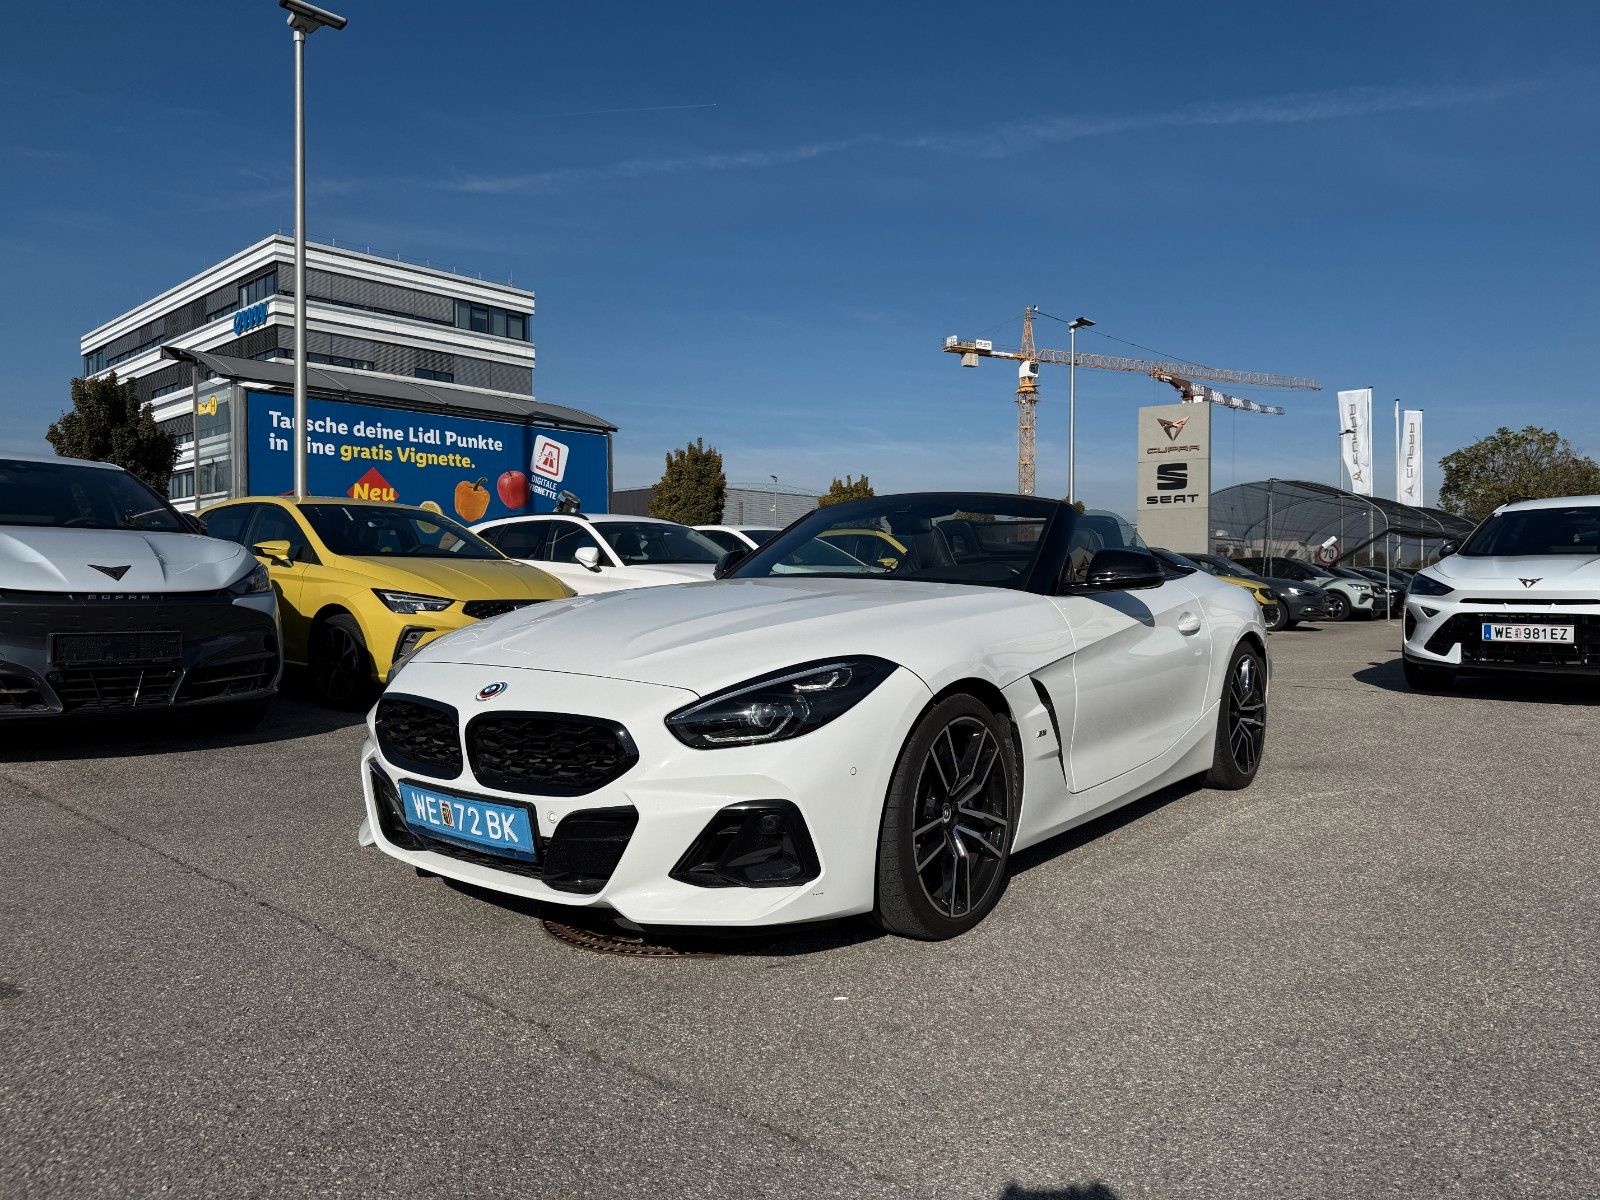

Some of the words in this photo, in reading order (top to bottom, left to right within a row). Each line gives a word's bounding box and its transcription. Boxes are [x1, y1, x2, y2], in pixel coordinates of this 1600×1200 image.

[269, 411, 348, 435] Tasche
[353, 421, 403, 441] deine
[409, 427, 441, 445] Lidl
[445, 431, 503, 451] Punkte
[269, 433, 289, 451] in
[304, 436, 336, 456] ine
[340, 444, 393, 462] gratis
[396, 446, 476, 468] Vignette.
[1147, 445, 1200, 455] CUPRA
[531, 474, 558, 491] DIGITALE
[353, 483, 396, 502] Neu
[529, 483, 558, 500] VIGNETTE
[1146, 494, 1199, 505] SEAT
[1494, 626, 1513, 639] WE
[412, 791, 440, 826] WE
